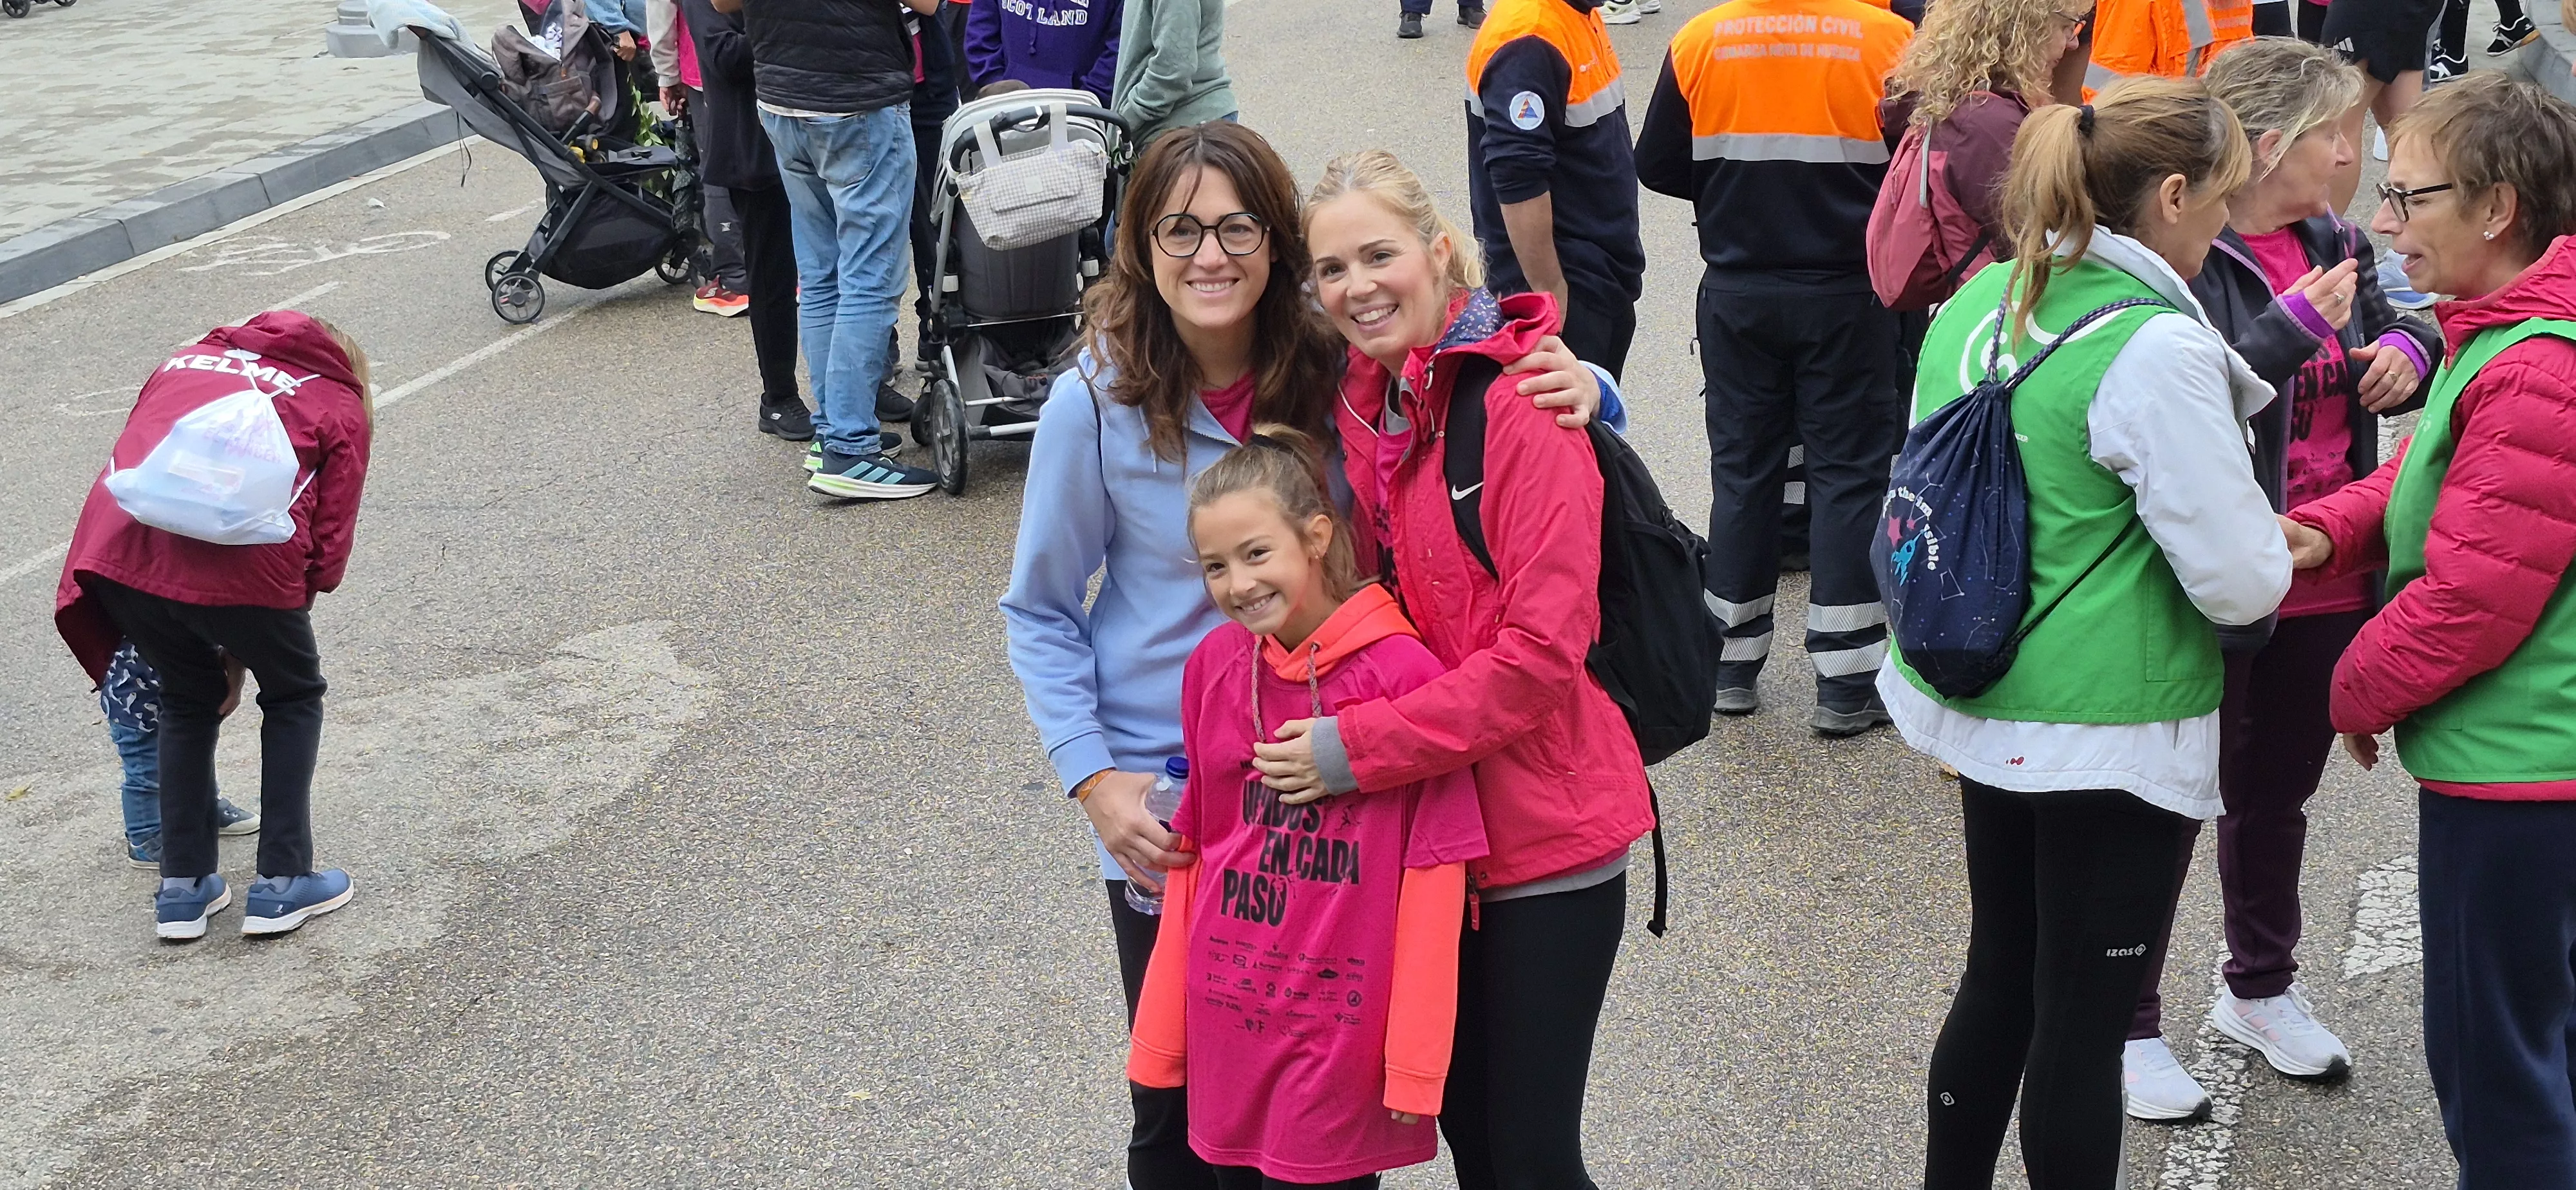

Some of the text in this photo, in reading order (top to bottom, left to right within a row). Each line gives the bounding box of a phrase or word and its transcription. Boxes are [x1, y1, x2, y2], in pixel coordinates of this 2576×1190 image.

[1714, 10, 1863, 39] PROTECCIÓN CIVIL
[164, 354, 301, 396] KELME
[1898, 486, 1915, 502] the
[1258, 829, 1359, 885] EN CADA
[1221, 869, 1287, 927] PASO
